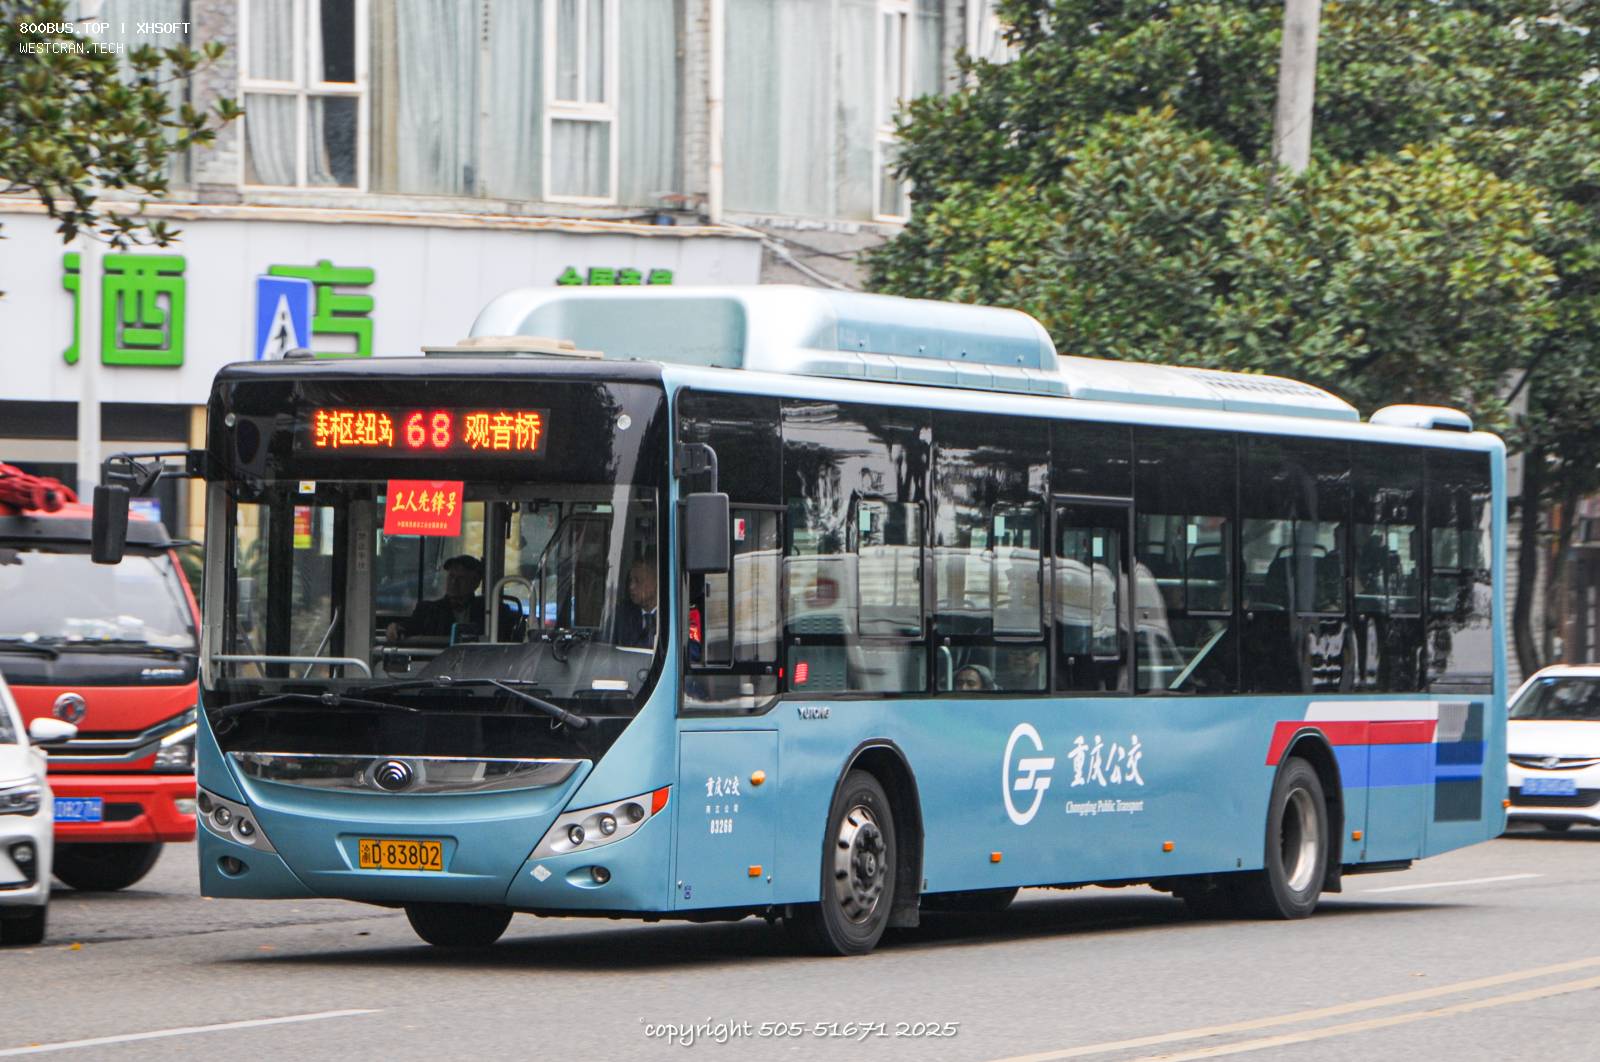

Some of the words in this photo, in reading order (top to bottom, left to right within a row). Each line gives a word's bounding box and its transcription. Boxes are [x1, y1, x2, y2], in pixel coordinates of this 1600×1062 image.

[405, 412, 452, 448] 68
[463, 411, 542, 450] 观音桥
[391, 489, 457, 517] 工人先锋号
[1067, 734, 1145, 787] 重庆公交
[705, 776, 740, 797] 重庆公交
[1097, 799, 1116, 813] Public
